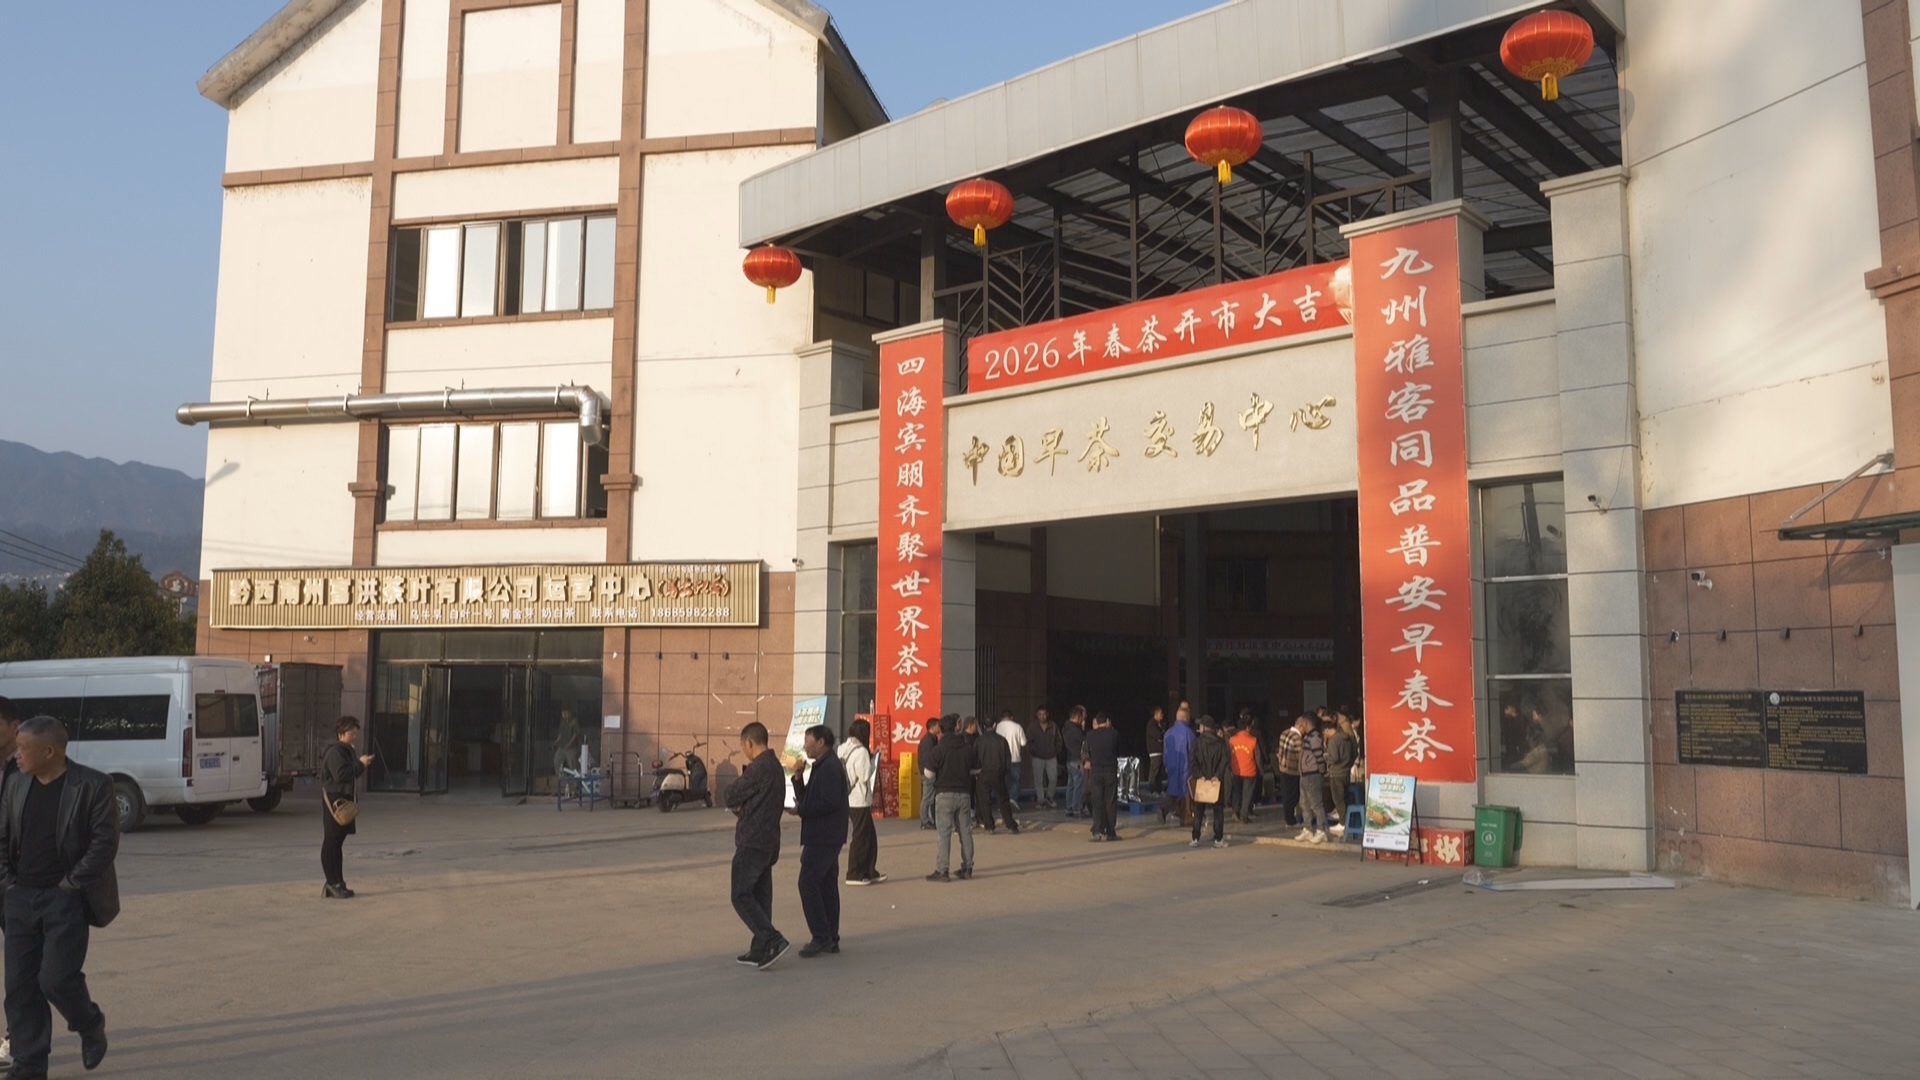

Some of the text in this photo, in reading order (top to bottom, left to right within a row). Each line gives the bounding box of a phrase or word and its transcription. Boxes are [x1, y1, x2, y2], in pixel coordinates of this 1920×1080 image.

[984, 285, 1322, 380] 2026年春茶开市大吉
[651, 606, 730, 617] 18685982288
[891, 355, 930, 744] 四海宾朋齐聚世界茶源地
[1380, 246, 1454, 762] 九州雅客同品普安早春茶
